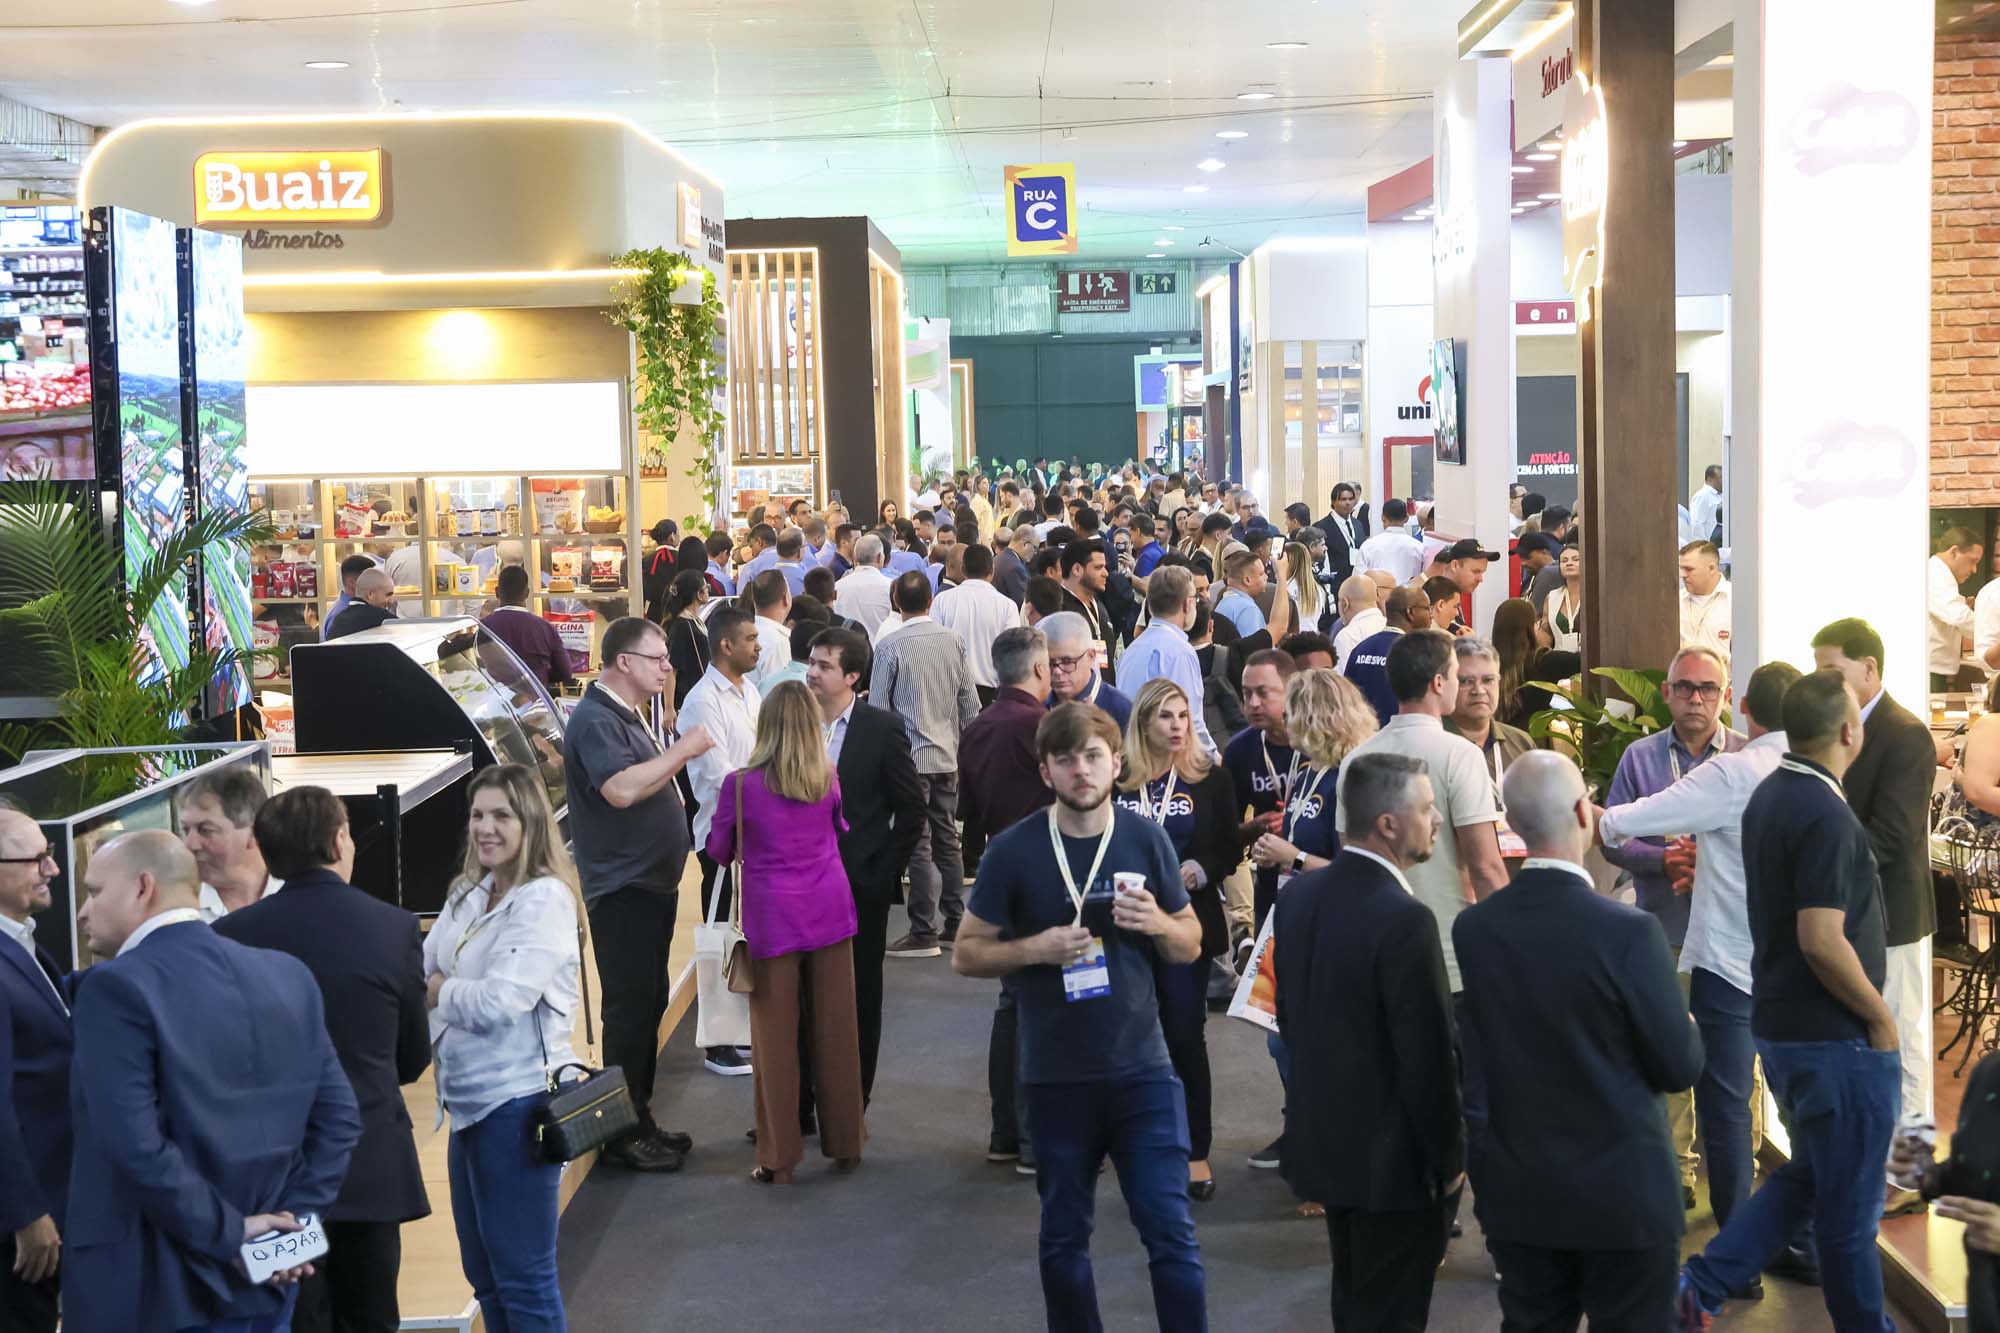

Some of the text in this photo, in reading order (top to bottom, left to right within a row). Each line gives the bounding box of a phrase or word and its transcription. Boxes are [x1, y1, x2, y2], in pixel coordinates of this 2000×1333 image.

[205, 160, 370, 211] Buaiz
[1024, 189, 1057, 202] RUA
[1025, 202, 1057, 230] C
[242, 228, 344, 248] Alimentos
[1398, 401, 1432, 419] uni
[1529, 451, 1570, 465] ATENÇÃO
[1544, 463, 1575, 475] FORTES
